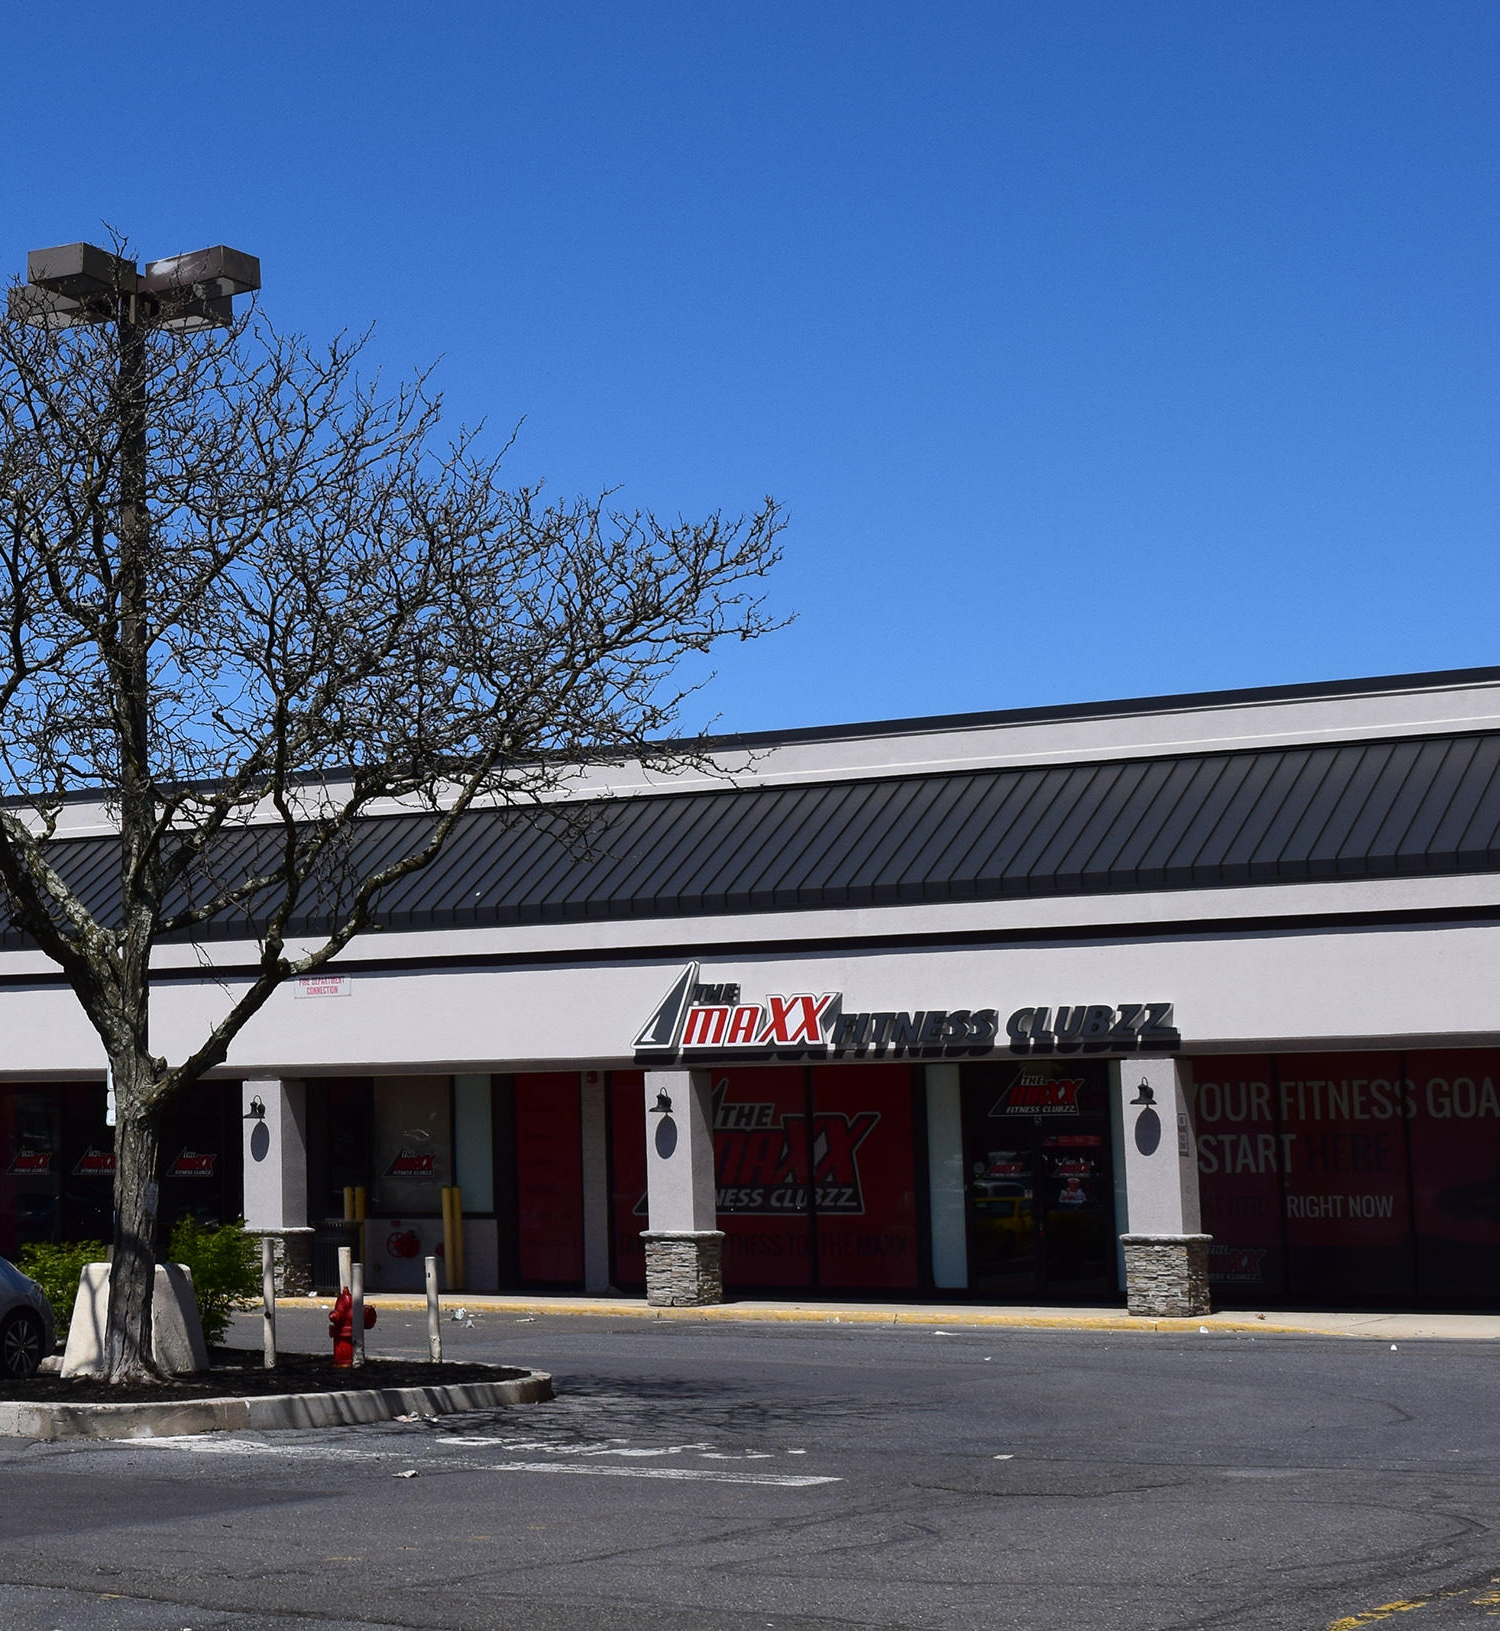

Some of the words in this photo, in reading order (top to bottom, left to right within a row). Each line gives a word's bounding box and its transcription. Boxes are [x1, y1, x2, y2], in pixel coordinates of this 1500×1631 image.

[307, 986, 338, 995] CONNECTION
[694, 983, 741, 1002] THE
[831, 1009, 998, 1045] FITNESS
[1006, 1003, 1180, 1040] CLUBZZ
[1042, 1105, 1076, 1113] CLUBZZ
[1281, 1078, 1417, 1120] FITNESS
[720, 1105, 772, 1126] THE
[1198, 1134, 1296, 1173] START
[715, 1188, 764, 1207] NESS
[1287, 1195, 1344, 1218] RIGHT
[1349, 1195, 1393, 1218] NOW
[721, 1232, 782, 1257] ITNESS
[819, 1232, 852, 1257] THE
[857, 1231, 909, 1257] MAXX
